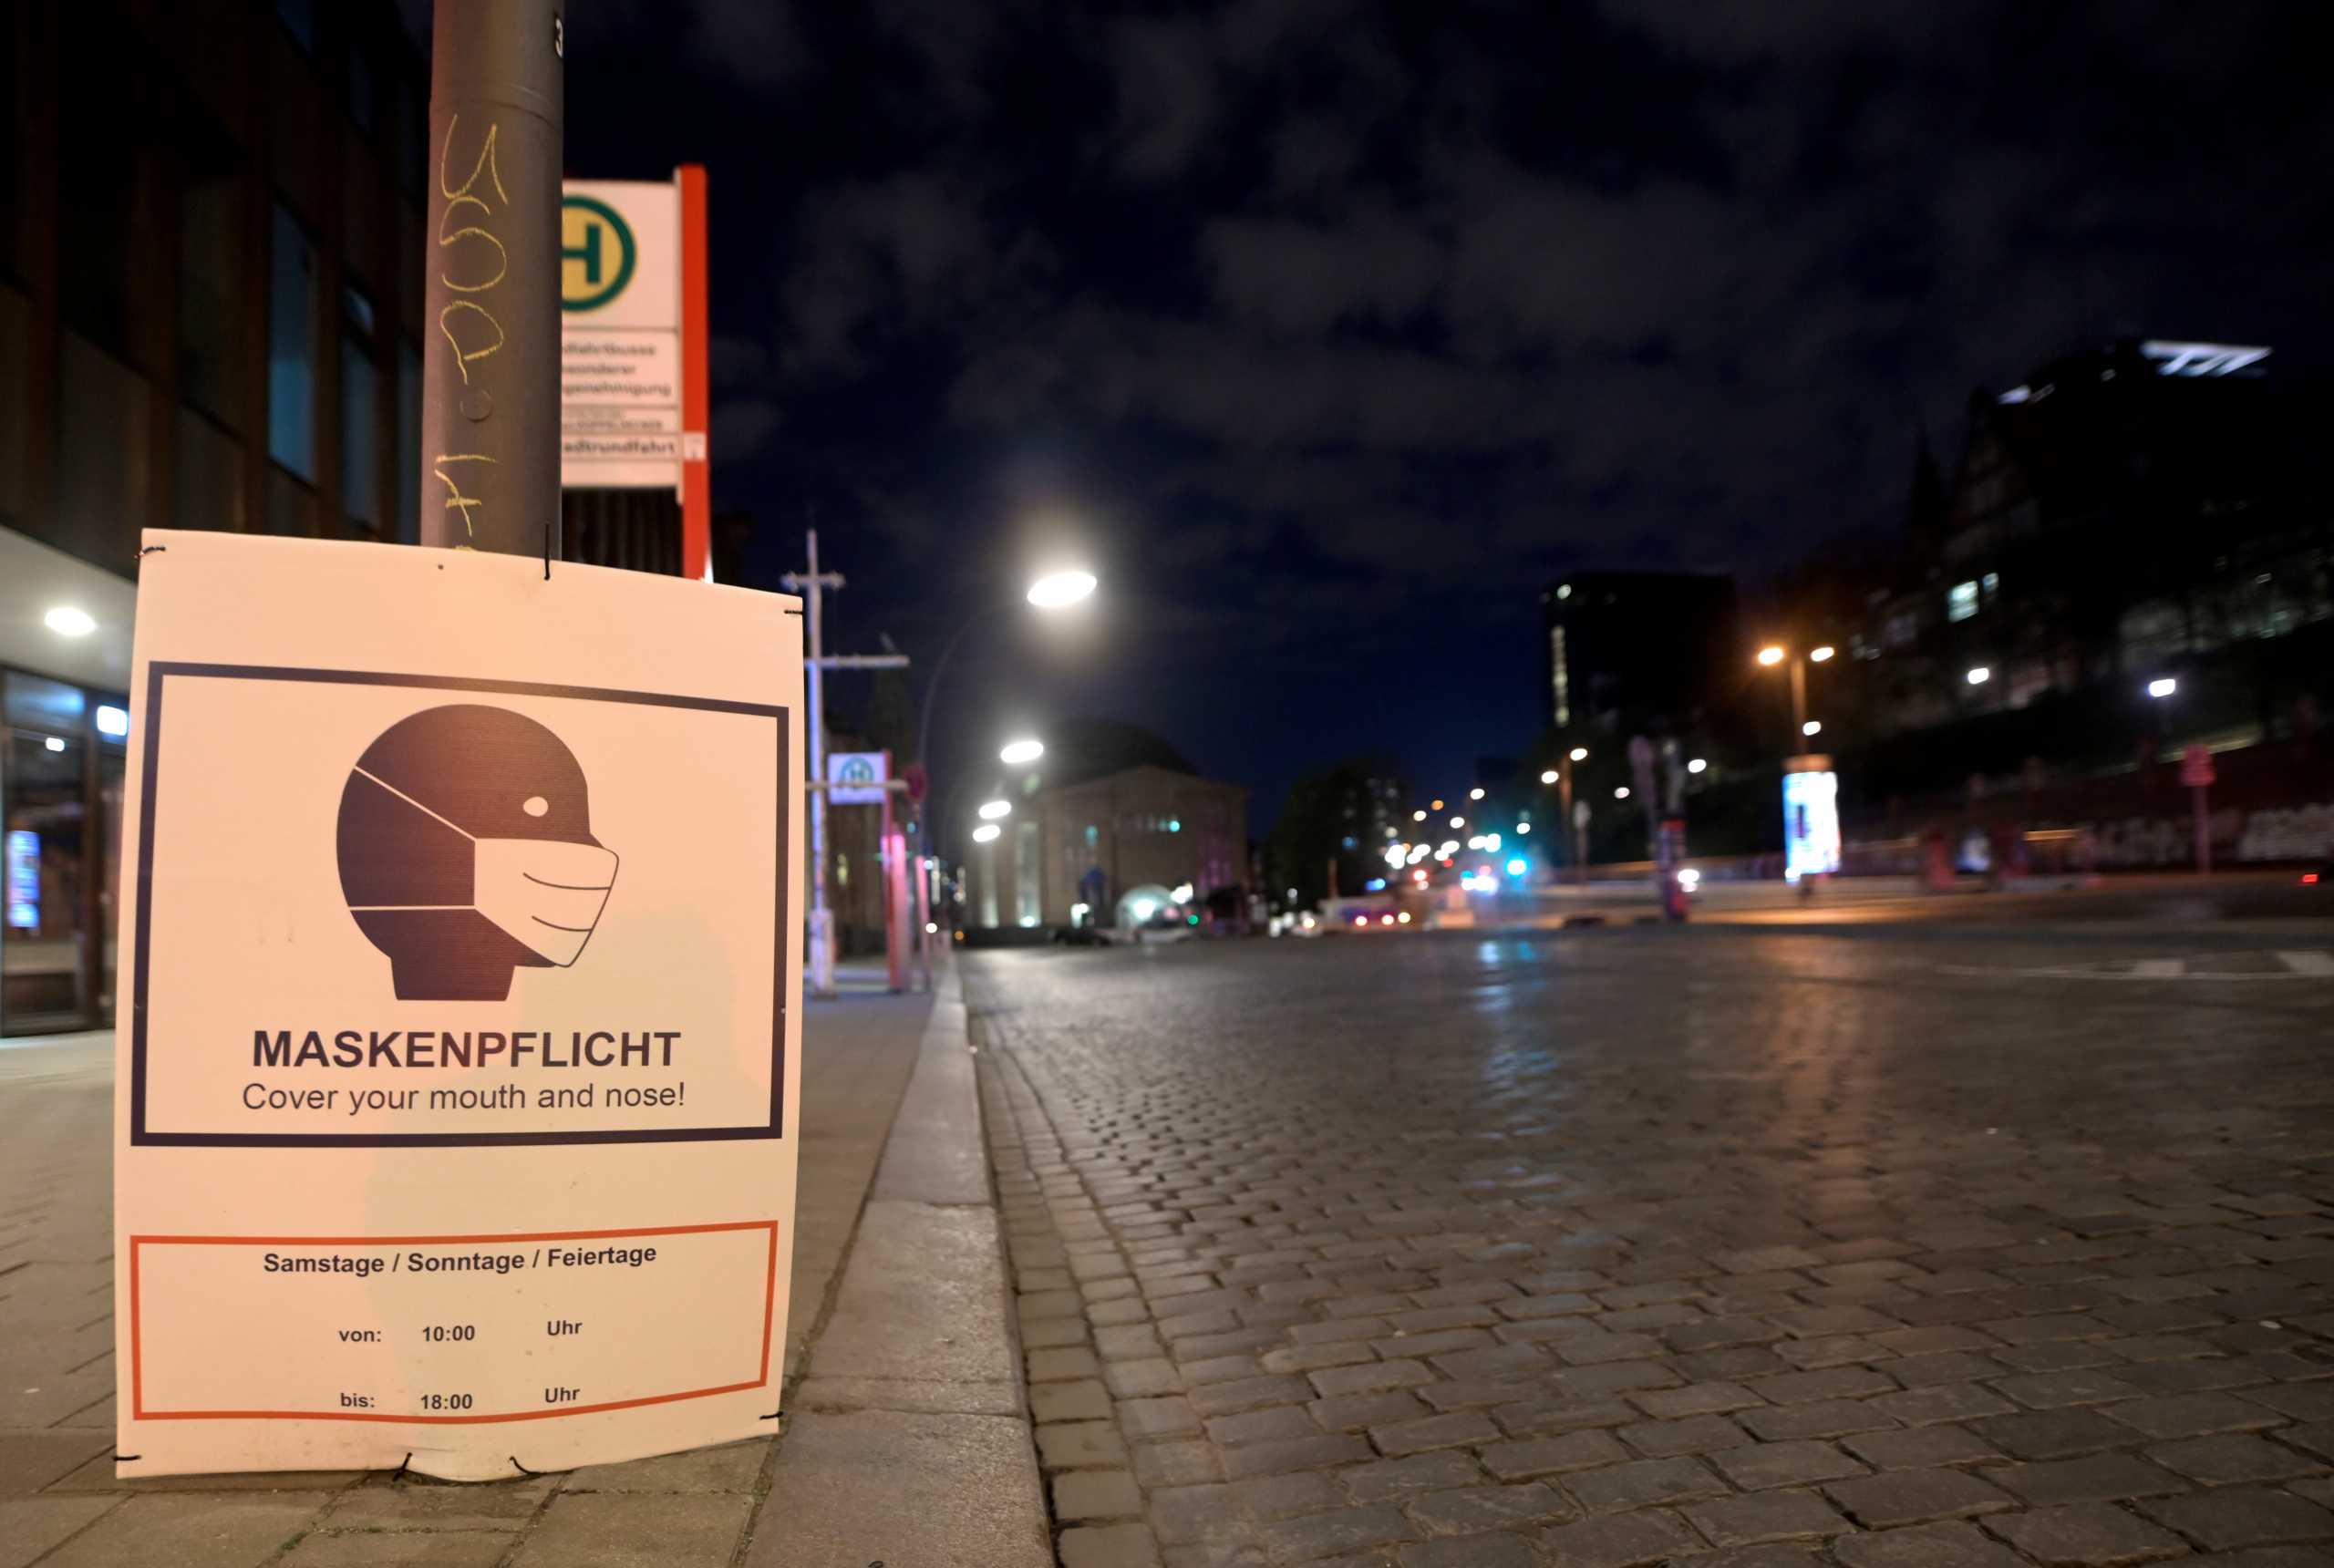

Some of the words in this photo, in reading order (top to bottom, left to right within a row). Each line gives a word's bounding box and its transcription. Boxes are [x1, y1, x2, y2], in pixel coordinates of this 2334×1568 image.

[253, 1030, 682, 1068] MASKENPFLICHT
[243, 1082, 338, 1110] Cover
[349, 1089, 419, 1117] your
[429, 1083, 526, 1109] mouth
[537, 1082, 594, 1109] and
[605, 1081, 686, 1108] nose!
[263, 1253, 385, 1277] Samstage
[391, 1253, 401, 1273] /
[408, 1252, 525, 1274] Sonntage
[532, 1249, 541, 1269] /
[548, 1245, 657, 1267] Feiertage
[338, 1330, 382, 1343] von:
[422, 1325, 476, 1342] 10:00
[547, 1318, 584, 1336] Uhr
[340, 1392, 375, 1408] bis:
[420, 1393, 473, 1410] 18:00
[544, 1387, 581, 1404] Uhr
